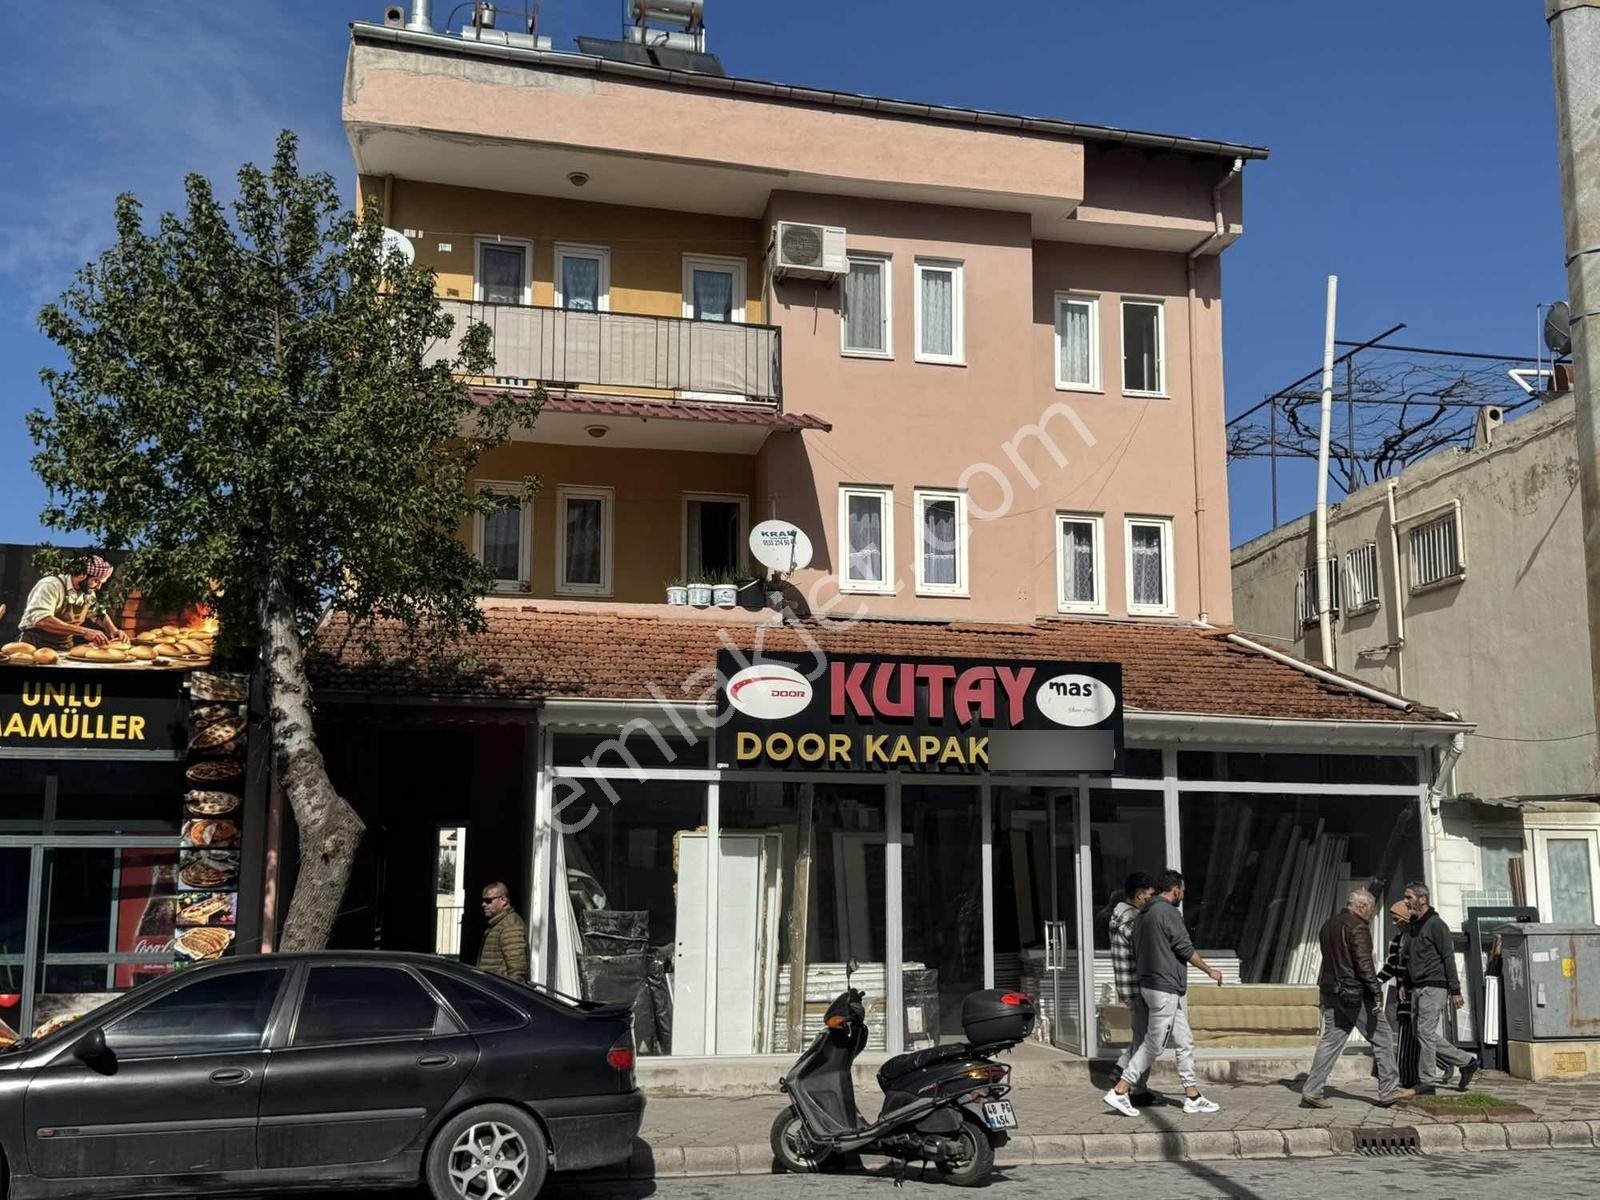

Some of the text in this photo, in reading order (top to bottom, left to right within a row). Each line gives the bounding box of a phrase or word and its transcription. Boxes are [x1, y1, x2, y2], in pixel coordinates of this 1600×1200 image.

[22, 681, 102, 708] UNLU
[771, 690, 806, 698] DOOR
[830, 662, 1036, 727] KUTAY
[1049, 681, 1093, 697] mas
[0, 708, 146, 740] AMÜLLER
[736, 732, 851, 762] DOOR
[996, 1115, 1010, 1125] 454
